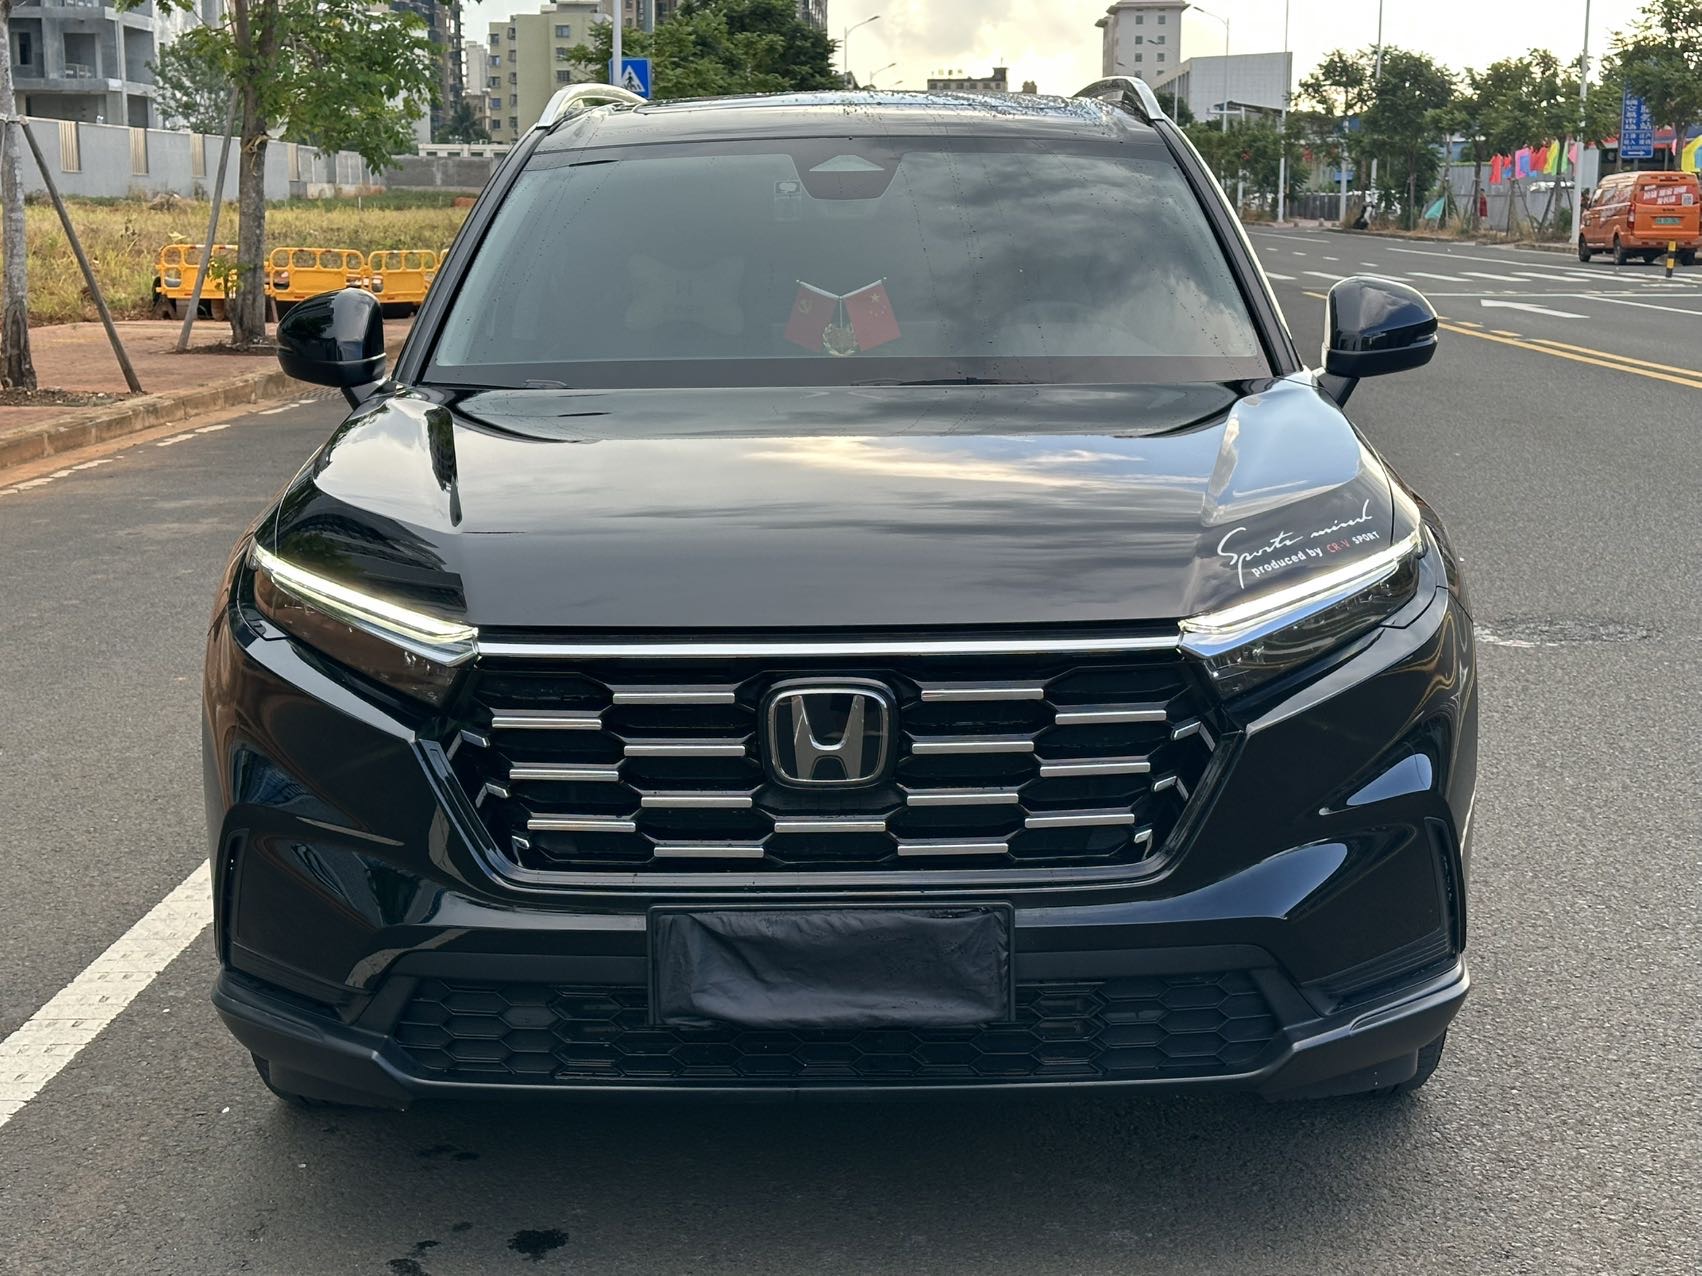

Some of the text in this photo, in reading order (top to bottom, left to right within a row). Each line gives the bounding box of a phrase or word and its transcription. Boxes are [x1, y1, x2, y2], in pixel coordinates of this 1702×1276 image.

[1217, 499, 1373, 589] Sports mind
[1251, 551, 1307, 578] produced
[1306, 546, 1324, 557] by
[1352, 530, 1381, 545] SPORT
